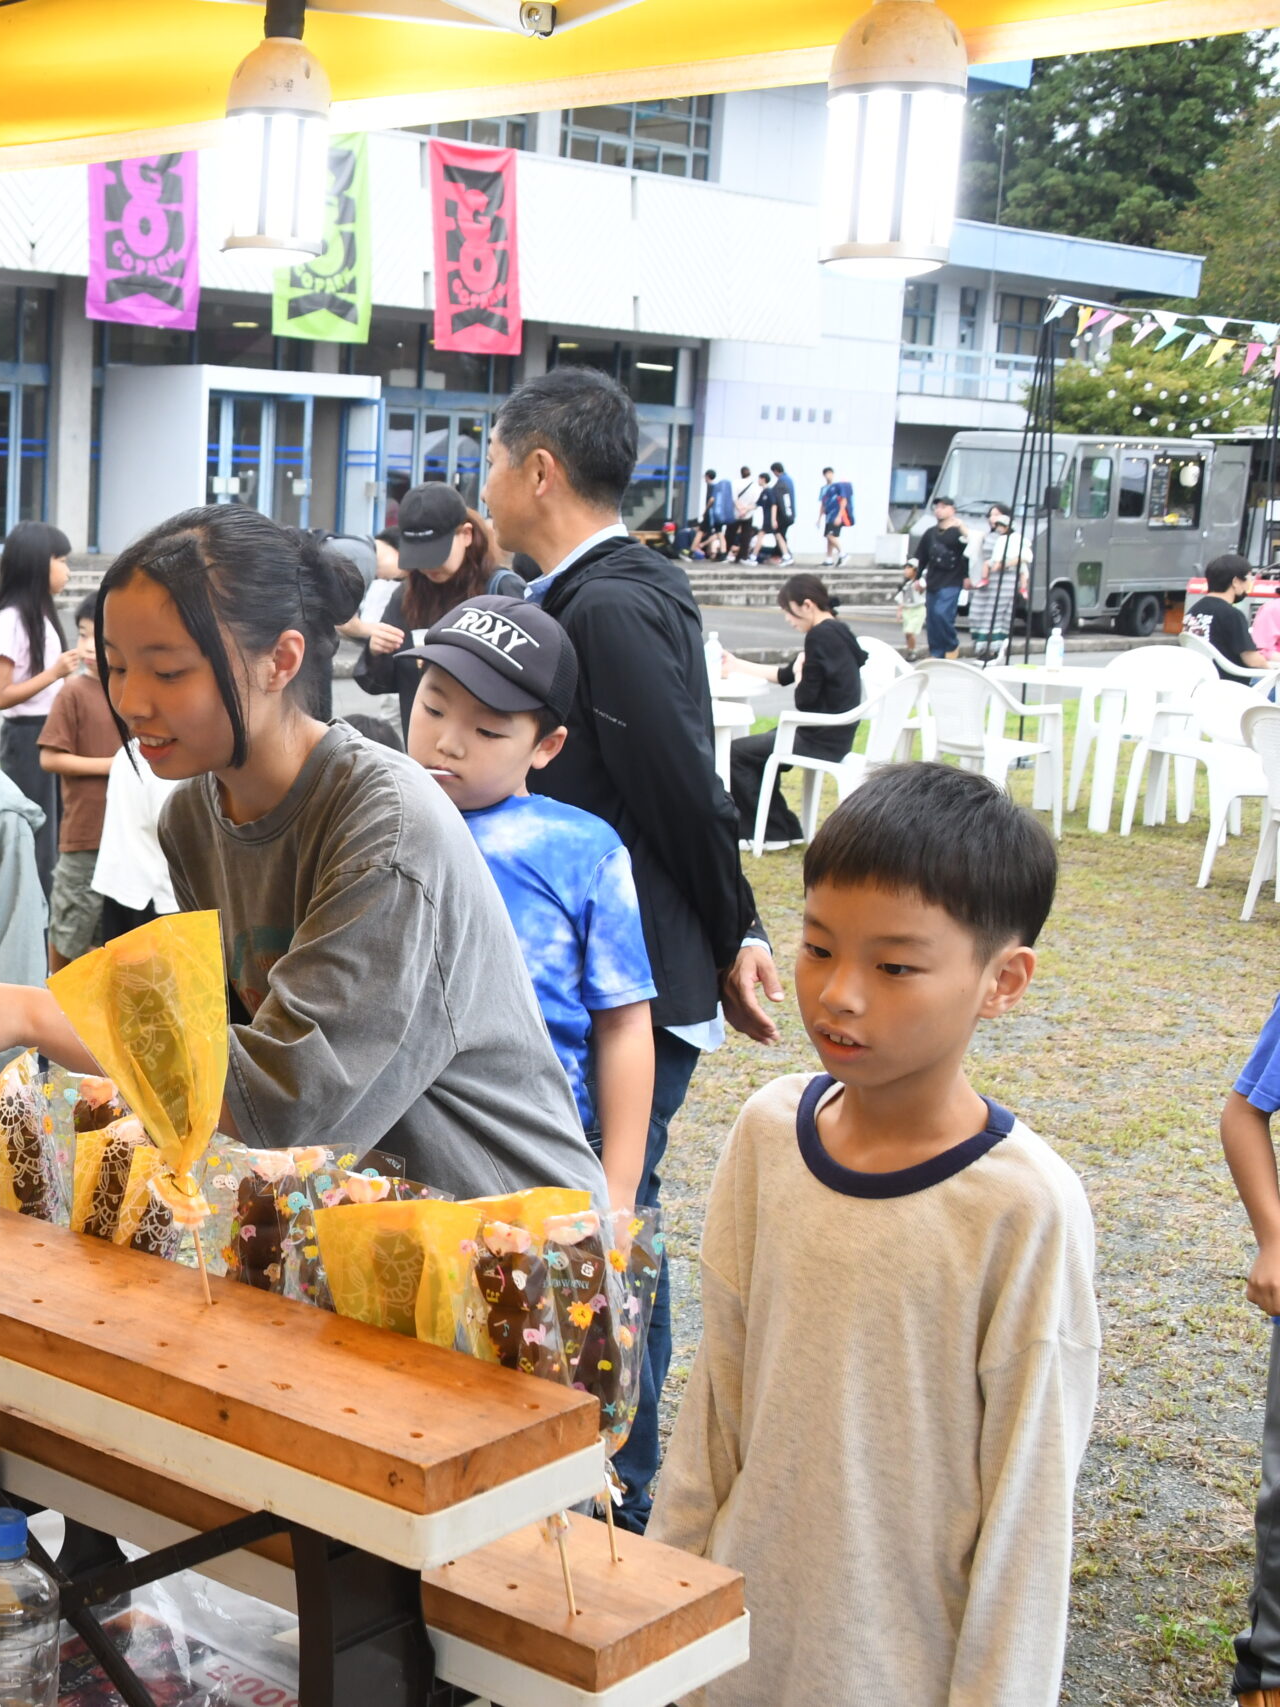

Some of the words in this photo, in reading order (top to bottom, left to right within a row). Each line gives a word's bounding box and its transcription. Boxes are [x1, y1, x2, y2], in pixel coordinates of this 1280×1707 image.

[112, 240, 176, 276] COPARK
[452, 278, 507, 309] COPARK
[452, 611, 528, 653] ROXY
